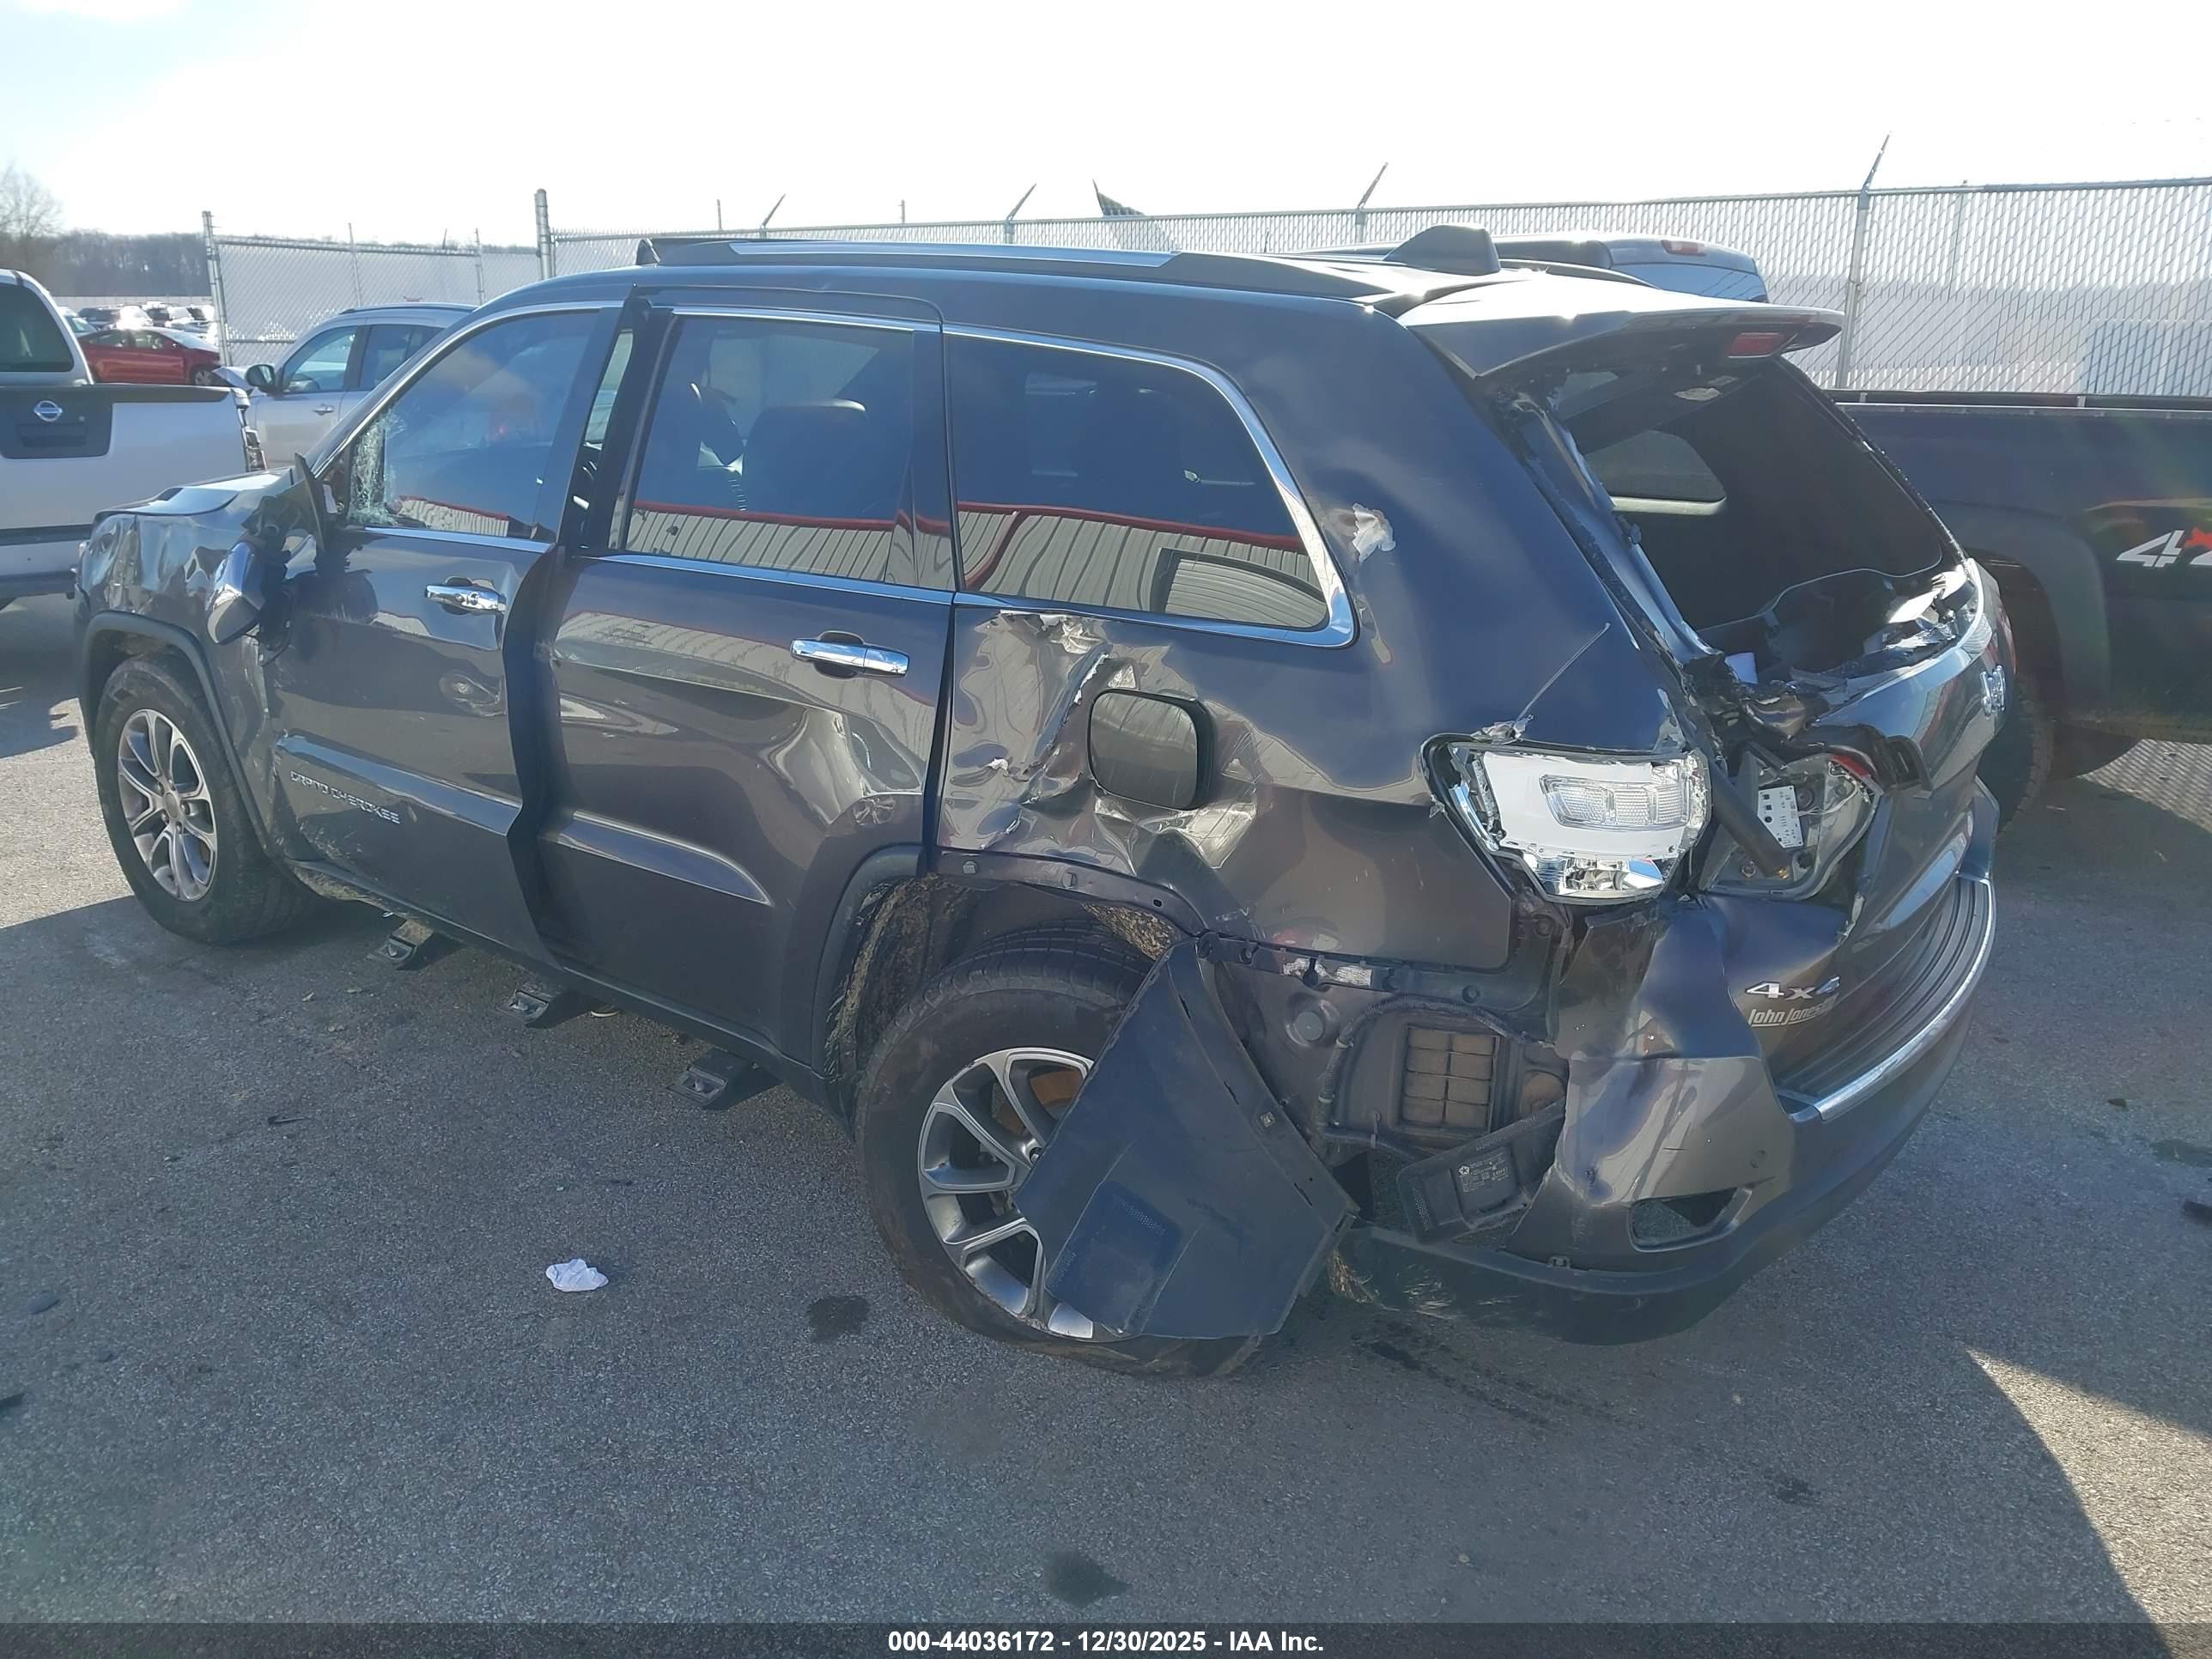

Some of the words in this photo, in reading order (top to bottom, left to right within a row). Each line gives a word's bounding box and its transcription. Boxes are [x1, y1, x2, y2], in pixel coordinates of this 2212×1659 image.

[289, 770, 328, 794] GRAND
[331, 787, 400, 825] CHEROKEE
[1747, 1008, 1786, 1025] John
